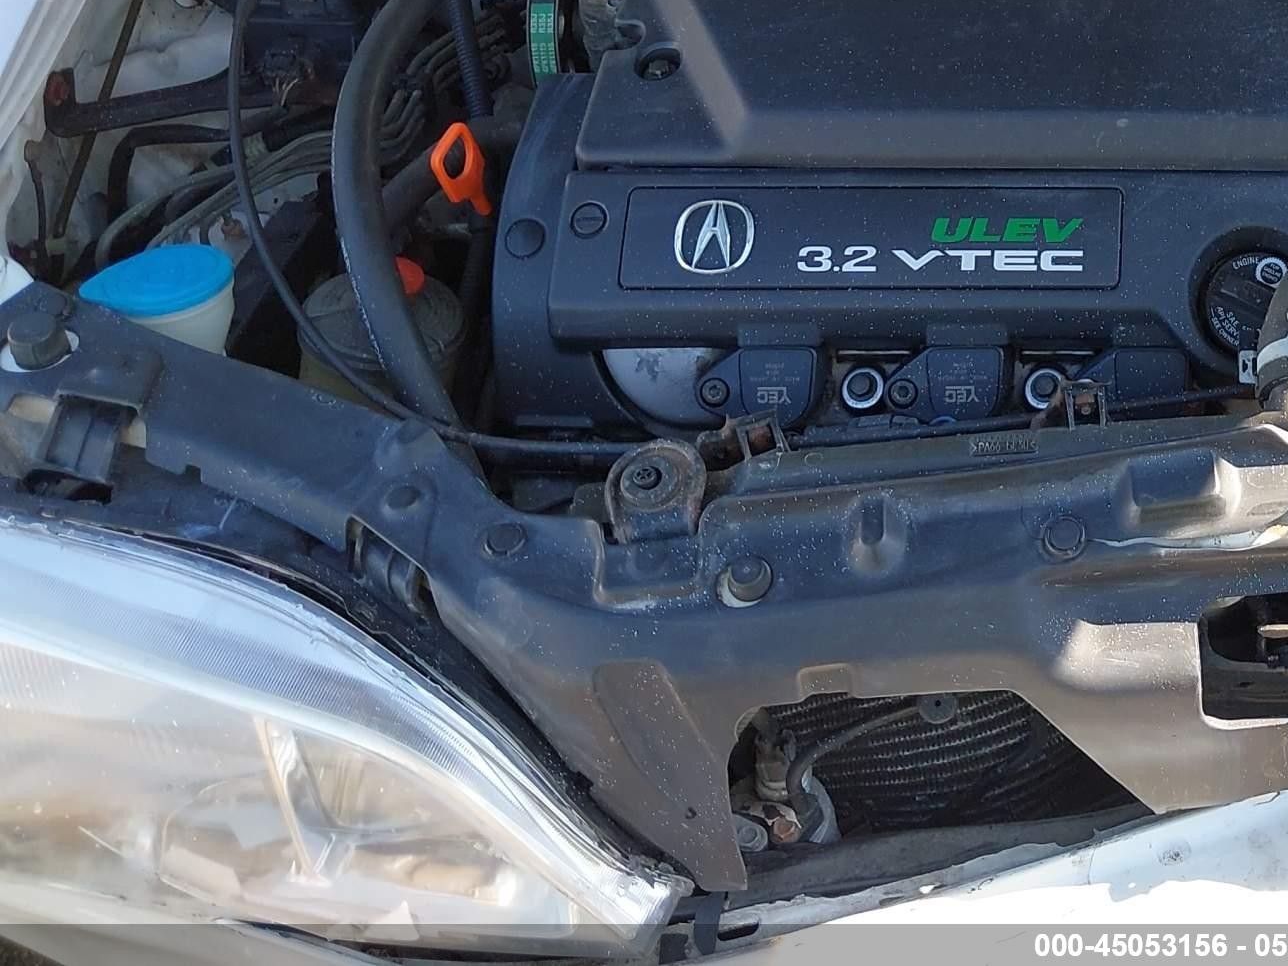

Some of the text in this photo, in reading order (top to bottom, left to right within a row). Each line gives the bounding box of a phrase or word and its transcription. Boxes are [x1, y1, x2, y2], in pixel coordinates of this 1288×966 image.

[931, 218, 1084, 243] ULEV
[797, 245, 1084, 272] 3.2 VTEC
[1232, 256, 1260, 270] ENGINE
[757, 386, 791, 404] YEC
[945, 385, 980, 403] YEC
